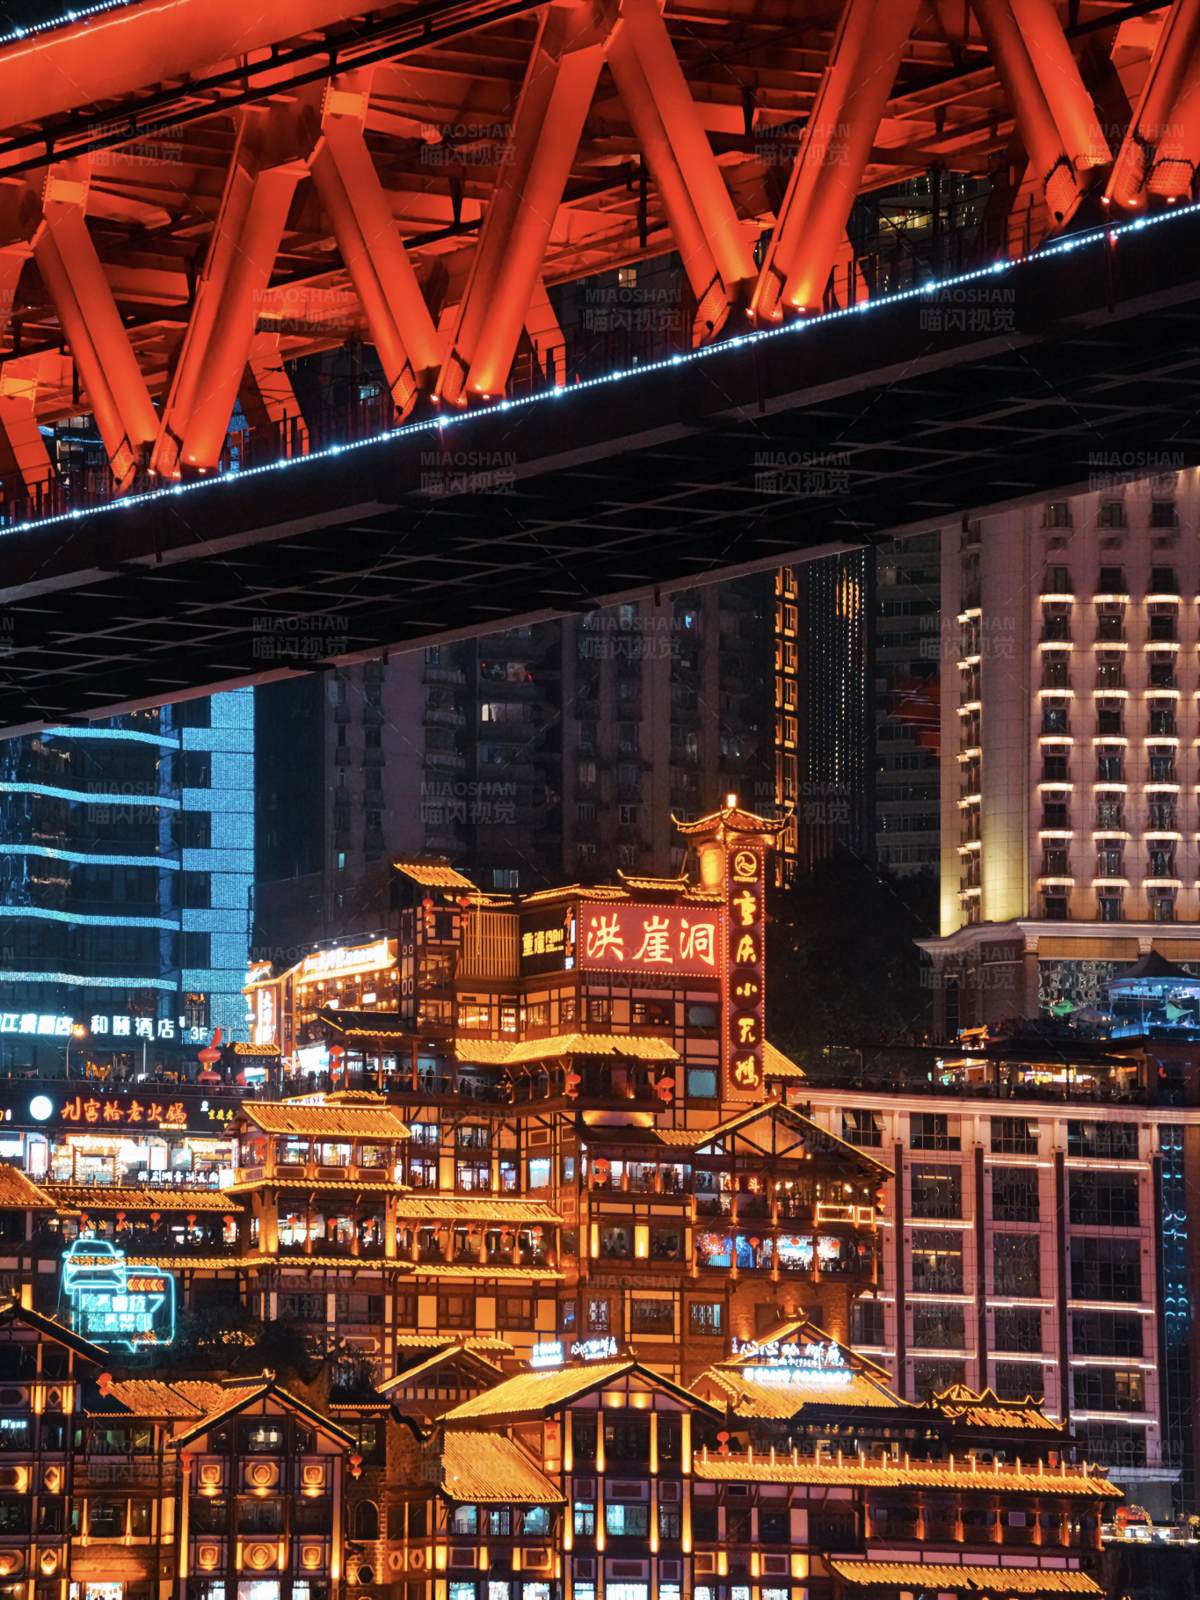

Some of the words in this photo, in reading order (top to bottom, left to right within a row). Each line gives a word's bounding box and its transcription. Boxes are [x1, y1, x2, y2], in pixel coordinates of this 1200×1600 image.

[587, 912, 715, 966] 洪崖洞
[733, 890, 758, 1086] 重庆小天鹅
[0, 1013, 73, 1036] 江景酒店
[90, 1014, 174, 1039] 和颐酒店
[190, 1026, 208, 1041] 3F
[61, 1096, 187, 1123] 九宫格老火锅
